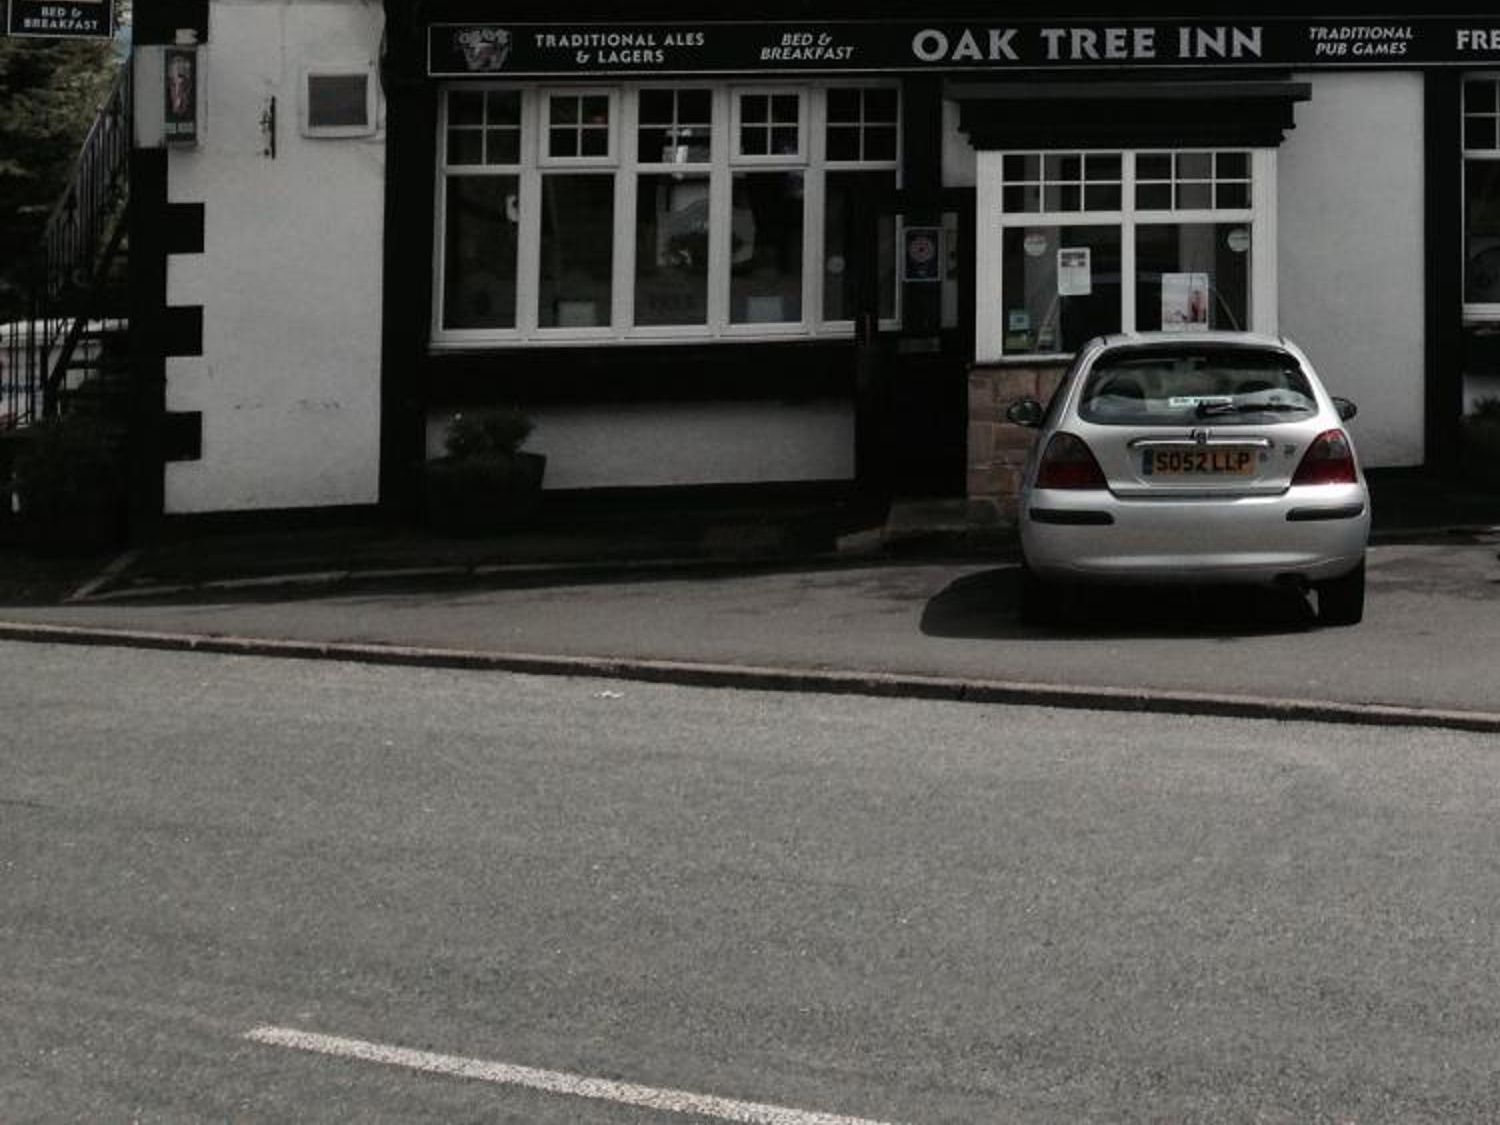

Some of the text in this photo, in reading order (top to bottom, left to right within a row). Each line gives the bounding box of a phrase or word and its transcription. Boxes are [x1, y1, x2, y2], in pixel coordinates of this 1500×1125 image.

[41, 6, 82, 18] BED &
[23, 18, 98, 30] BREAKFAST
[535, 32, 705, 48] TRADITIONAL ALES
[780, 32, 833, 46] BED &
[1309, 26, 1413, 40] TRADITIONAL
[911, 26, 1263, 62] OAK TREE INN
[1315, 41, 1407, 56] PUB GAMES
[575, 48, 665, 64] & LAGERS
[760, 46, 854, 60] BREAKFAST
[1156, 451, 1250, 472] SO52 LLP
